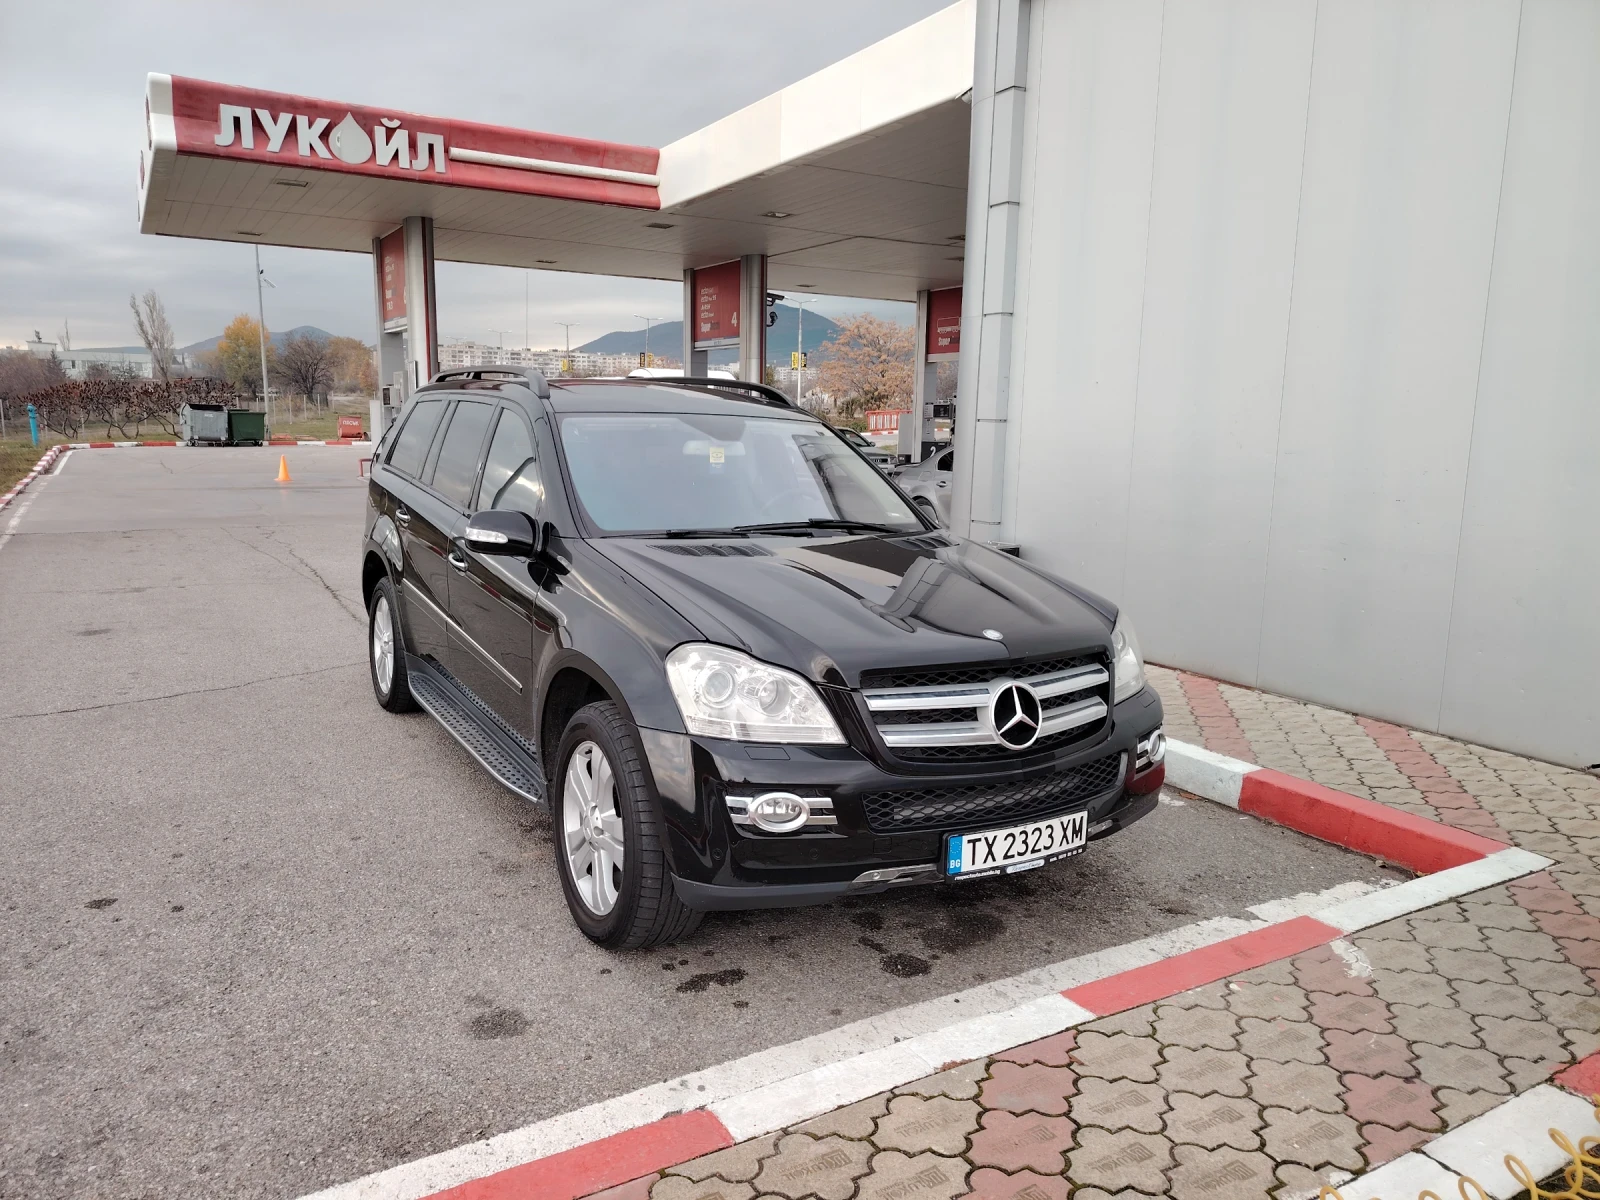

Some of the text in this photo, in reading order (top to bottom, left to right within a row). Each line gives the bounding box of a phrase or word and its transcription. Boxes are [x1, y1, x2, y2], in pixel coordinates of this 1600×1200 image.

[731, 311, 737, 327] 4
[967, 835, 997, 866] TX
[1002, 824, 1054, 860] 2323
[1059, 816, 1084, 847] XM
[949, 859, 961, 869] BG
